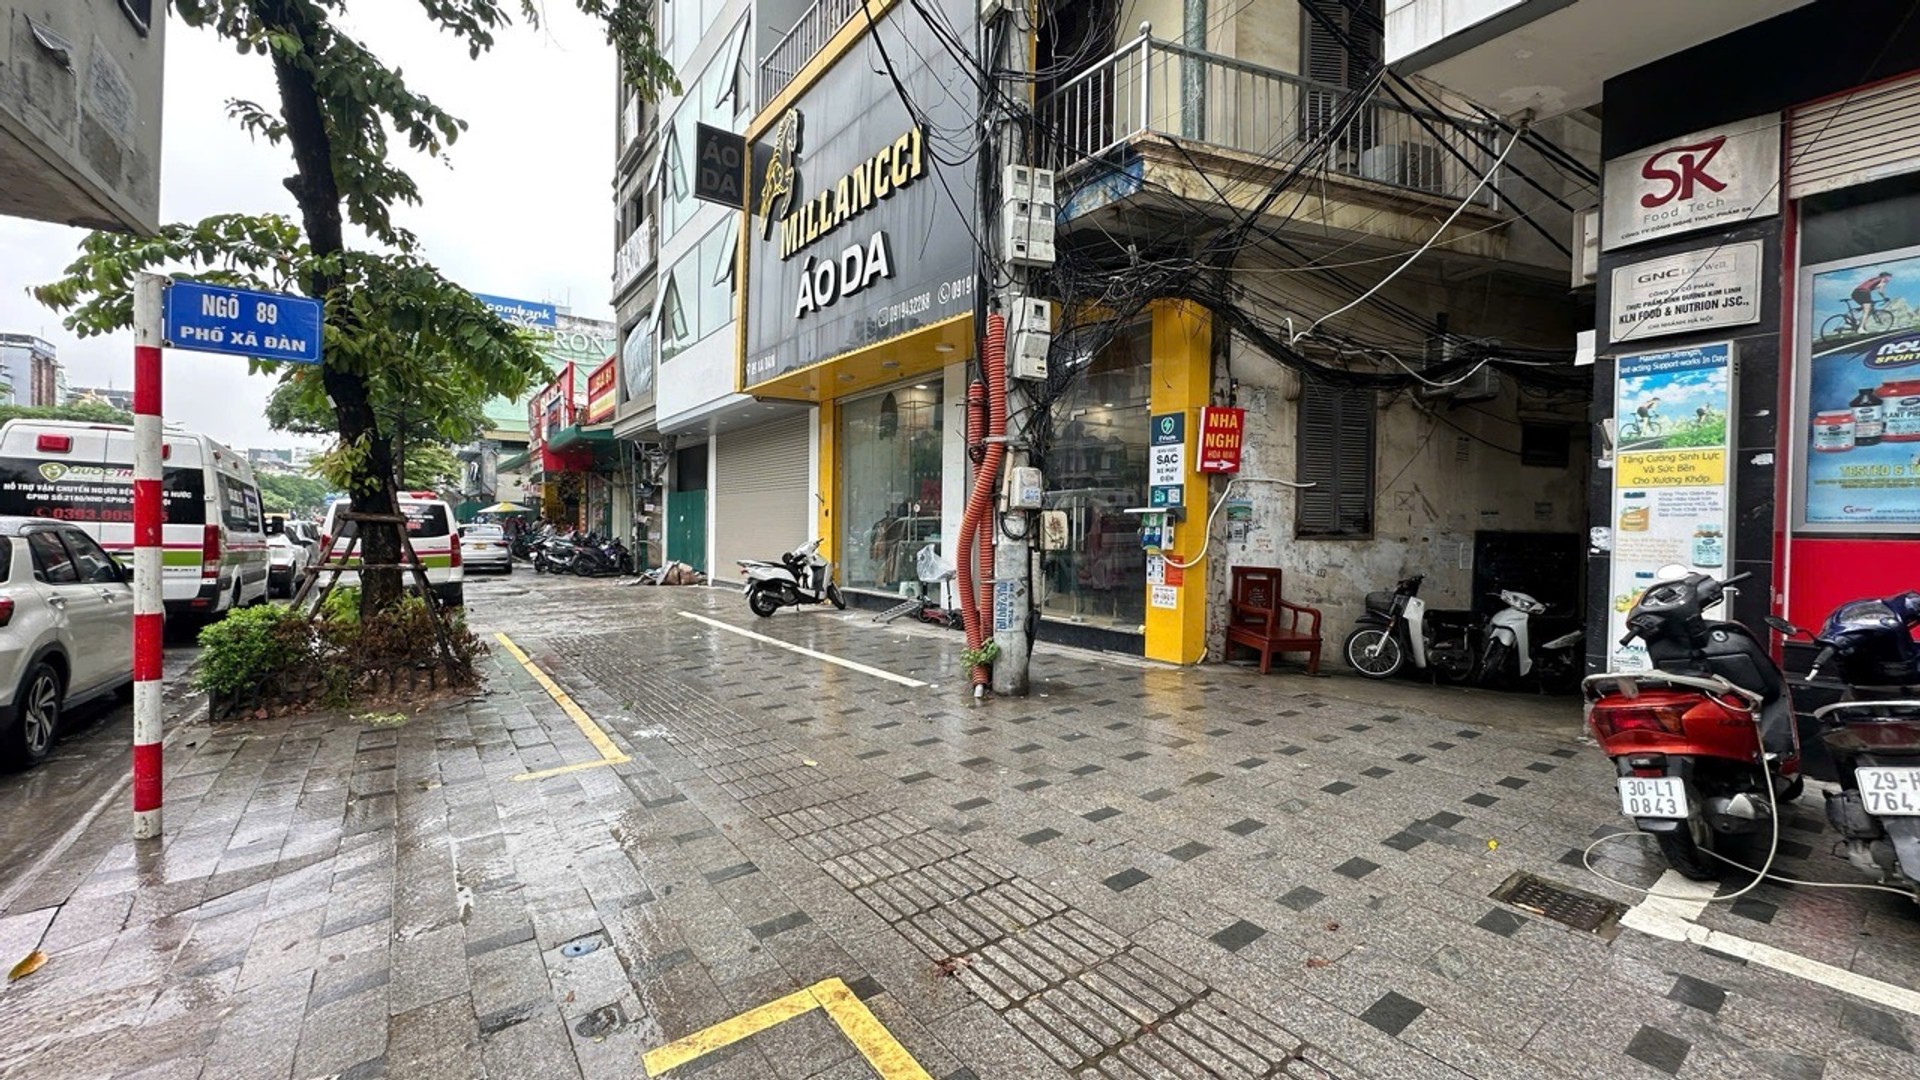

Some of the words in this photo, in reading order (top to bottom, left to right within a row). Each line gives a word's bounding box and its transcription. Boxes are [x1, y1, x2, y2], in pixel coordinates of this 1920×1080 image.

[703, 135, 740, 168] ÁO
[702, 167, 738, 197] DA
[1641, 135, 1728, 208] SK
[780, 125, 922, 261] MILLANCCI
[1643, 207, 1679, 224] Food
[1688, 197, 1725, 213] Tech
[795, 255, 836, 318] ÁO
[841, 230, 889, 297] DA
[1638, 268, 1680, 284] GNC
[202, 293, 240, 320] NGÕ
[256, 302, 279, 325] 89
[1618, 313, 1636, 325] KLN
[1638, 308, 1662, 321] FOOD
[1664, 306, 1672, 317] &
[1675, 298, 1719, 315] NUTRION
[180, 325, 226, 343] PHỐ
[230, 331, 259, 347] XÃ
[264, 334, 307, 353] ĐÀN
[1209, 410, 1238, 429] NHÀ
[1156, 453, 1179, 467] SẠC
[1679, 452, 1700, 460] Sinh
[1627, 780, 1674, 797] 30-L1
[1630, 797, 1677, 815] 0843
